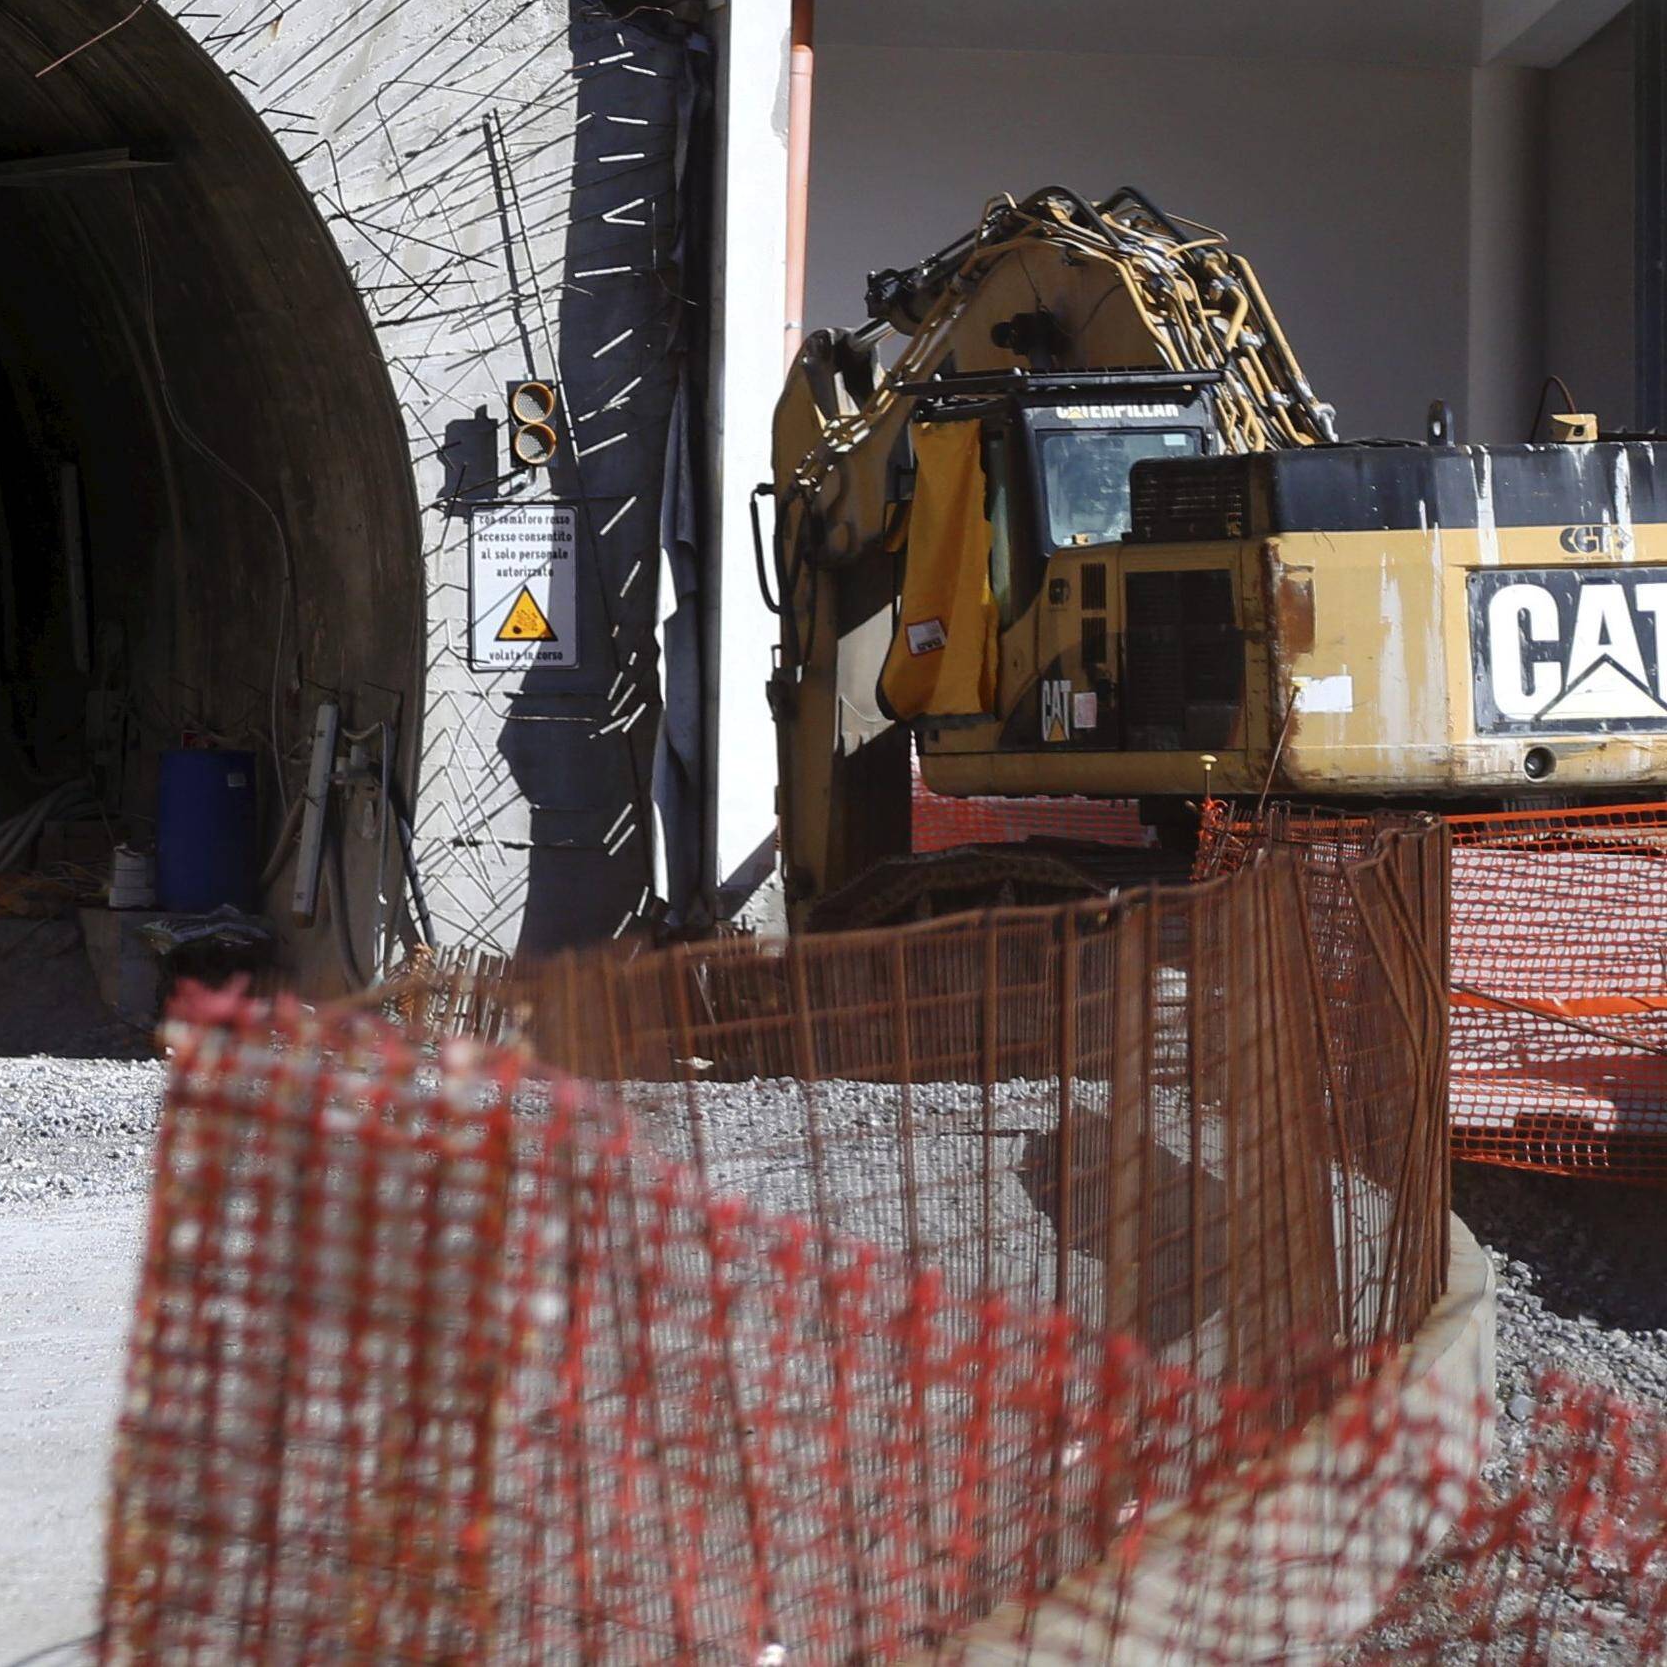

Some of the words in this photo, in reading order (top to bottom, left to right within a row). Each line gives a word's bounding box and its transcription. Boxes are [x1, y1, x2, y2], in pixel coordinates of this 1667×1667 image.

[479, 515, 496, 525] con
[499, 512, 542, 525] semaforo
[544, 515, 571, 525] rosso
[478, 533, 517, 542] accesso
[518, 531, 573, 542] consentito
[481, 547, 492, 560] al
[495, 547, 517, 560] solo
[518, 547, 569, 562] personale
[496, 566, 555, 577] autorizzato
[536, 651, 564, 661] corso
[1042, 680, 1072, 742] CAT
